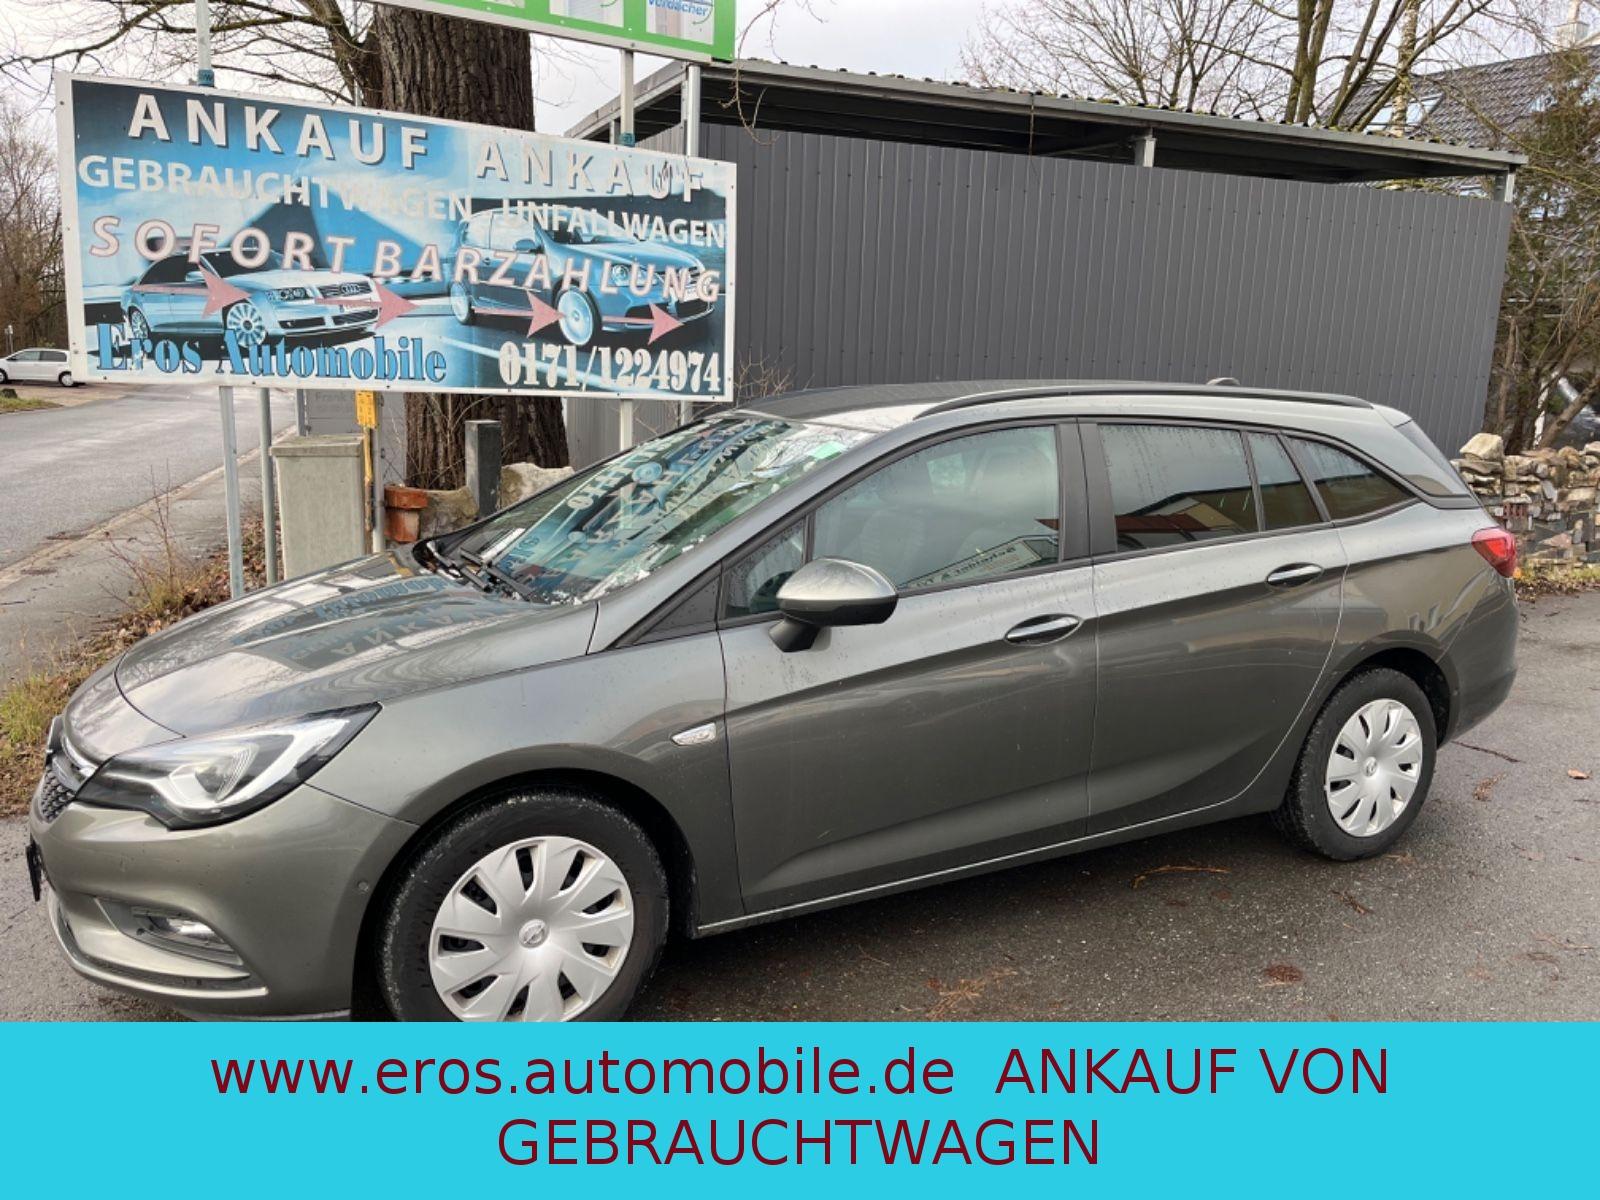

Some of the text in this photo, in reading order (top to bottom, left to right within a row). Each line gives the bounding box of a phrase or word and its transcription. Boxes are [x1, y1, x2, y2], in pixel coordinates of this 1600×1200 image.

[128, 93, 703, 203] ANKAUF ANKAUF
[78, 154, 725, 249] GEBRAUCHTWAGEN UNFALLWAGEN
[89, 215, 721, 302] SOFORT BARZAHLUNG
[96, 322, 447, 383] Eros Automobile
[499, 340, 721, 393] 0171/1224974
